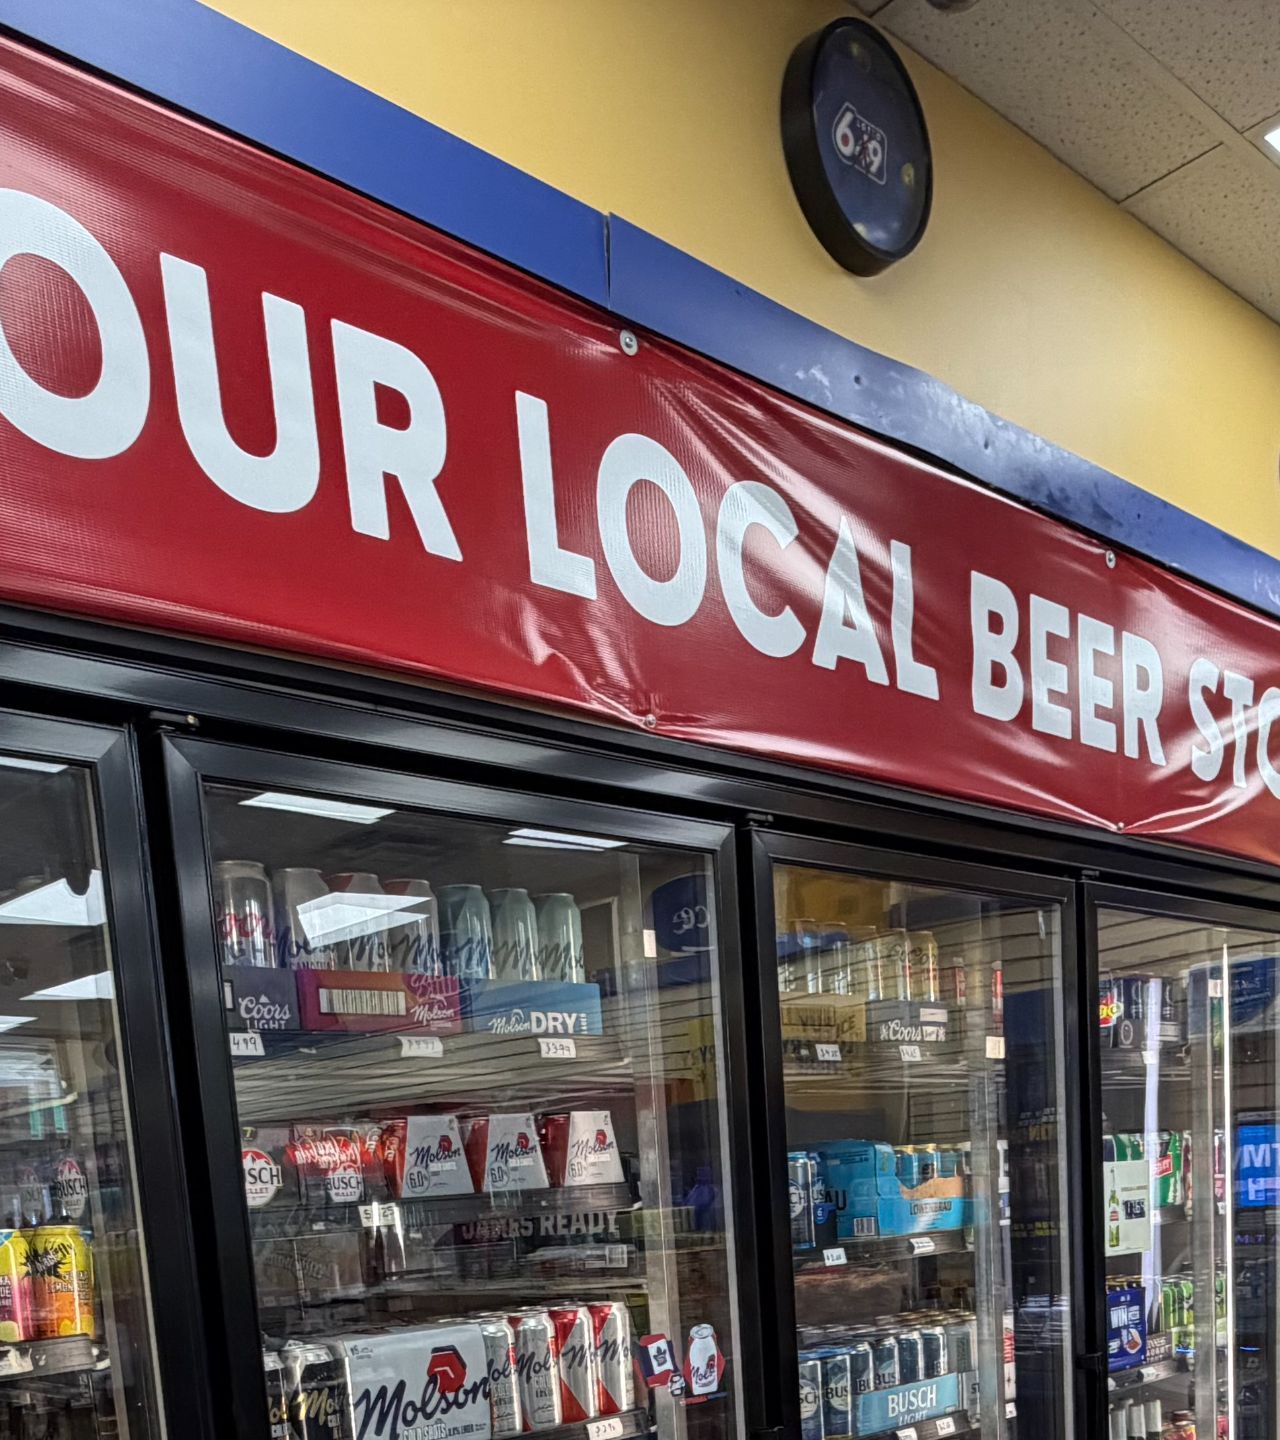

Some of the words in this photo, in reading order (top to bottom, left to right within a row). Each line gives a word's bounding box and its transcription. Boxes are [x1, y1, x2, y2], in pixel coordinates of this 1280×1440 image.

[515, 390, 939, 700] LOCAL
[970, 570, 1166, 767] BEER
[239, 1000, 292, 1023] Coors
[410, 1003, 456, 1024] Molson
[488, 1014, 531, 1035] Molson
[531, 1012, 578, 1035] DRY
[887, 1018, 922, 1042] Coors
[410, 1143, 462, 1171] Molson
[491, 1140, 540, 1167] Molson
[571, 1136, 618, 1161] Molson
[888, 1384, 938, 1418] BUSCH
